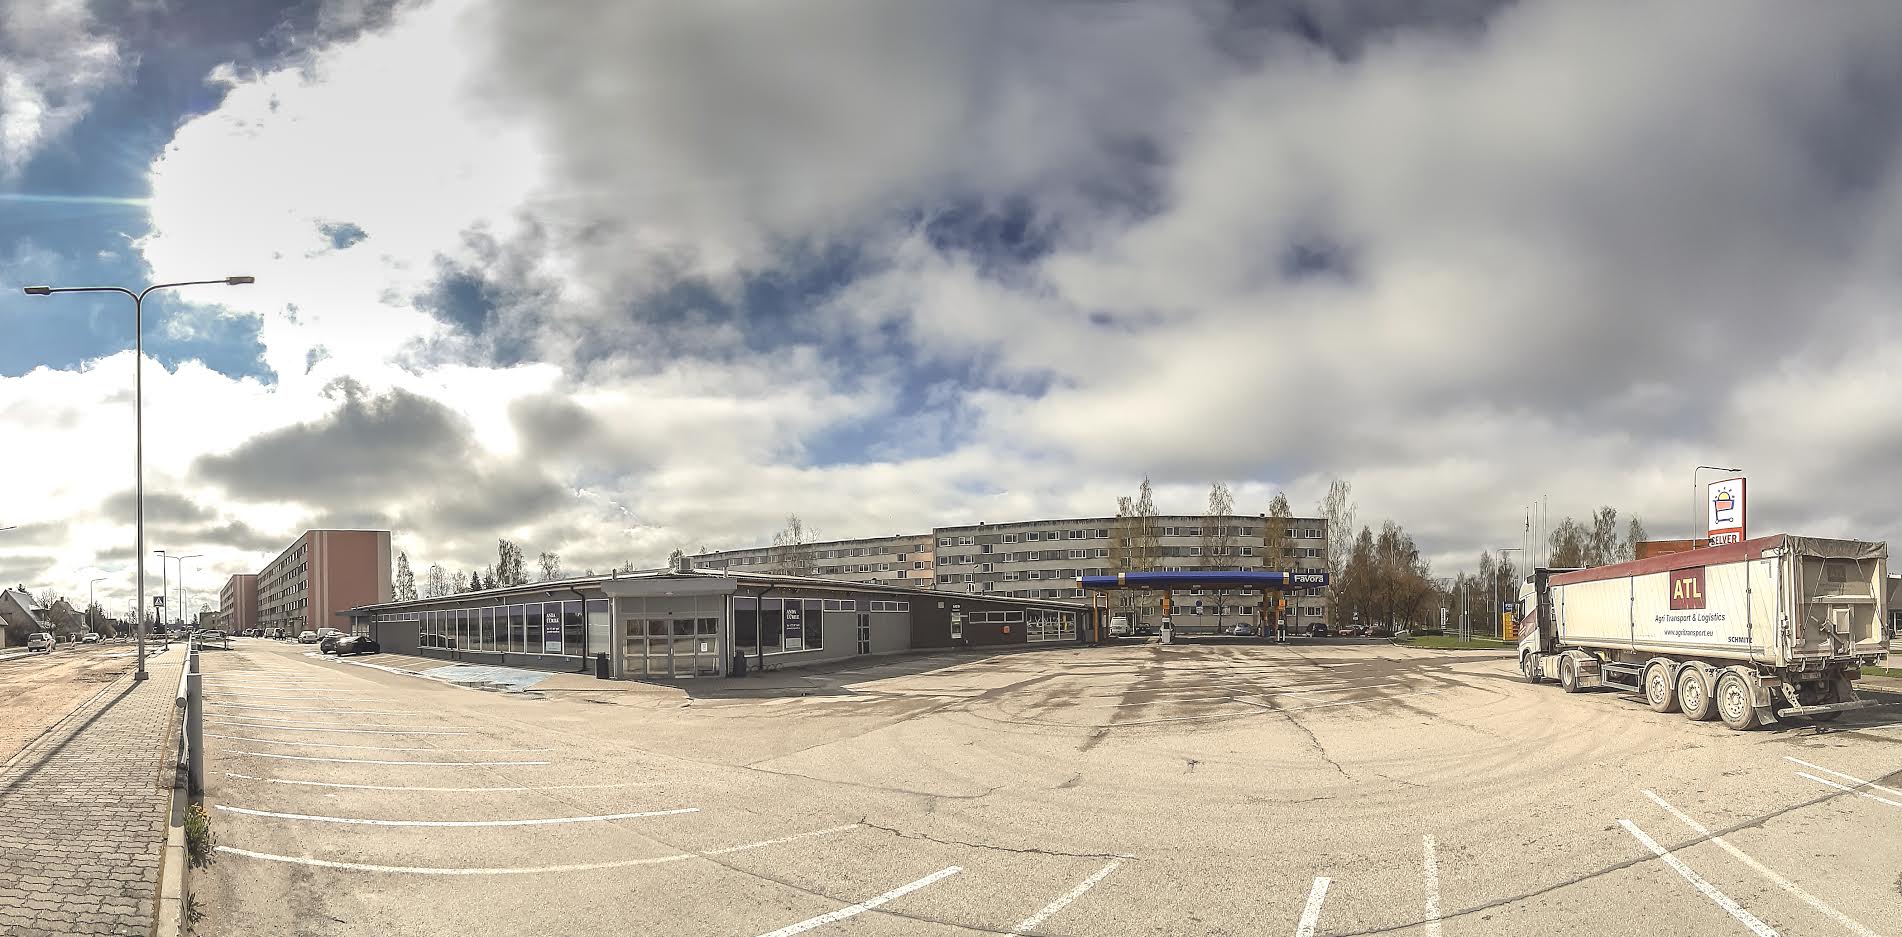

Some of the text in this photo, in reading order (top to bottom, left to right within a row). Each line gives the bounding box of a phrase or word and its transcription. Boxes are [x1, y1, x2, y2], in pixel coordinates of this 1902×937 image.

[1711, 534, 1737, 546] SELVER
[1294, 574, 1324, 583] Favora
[1673, 577, 1702, 600] ATL
[1655, 612, 1726, 624] Agri Transport & Logistics
